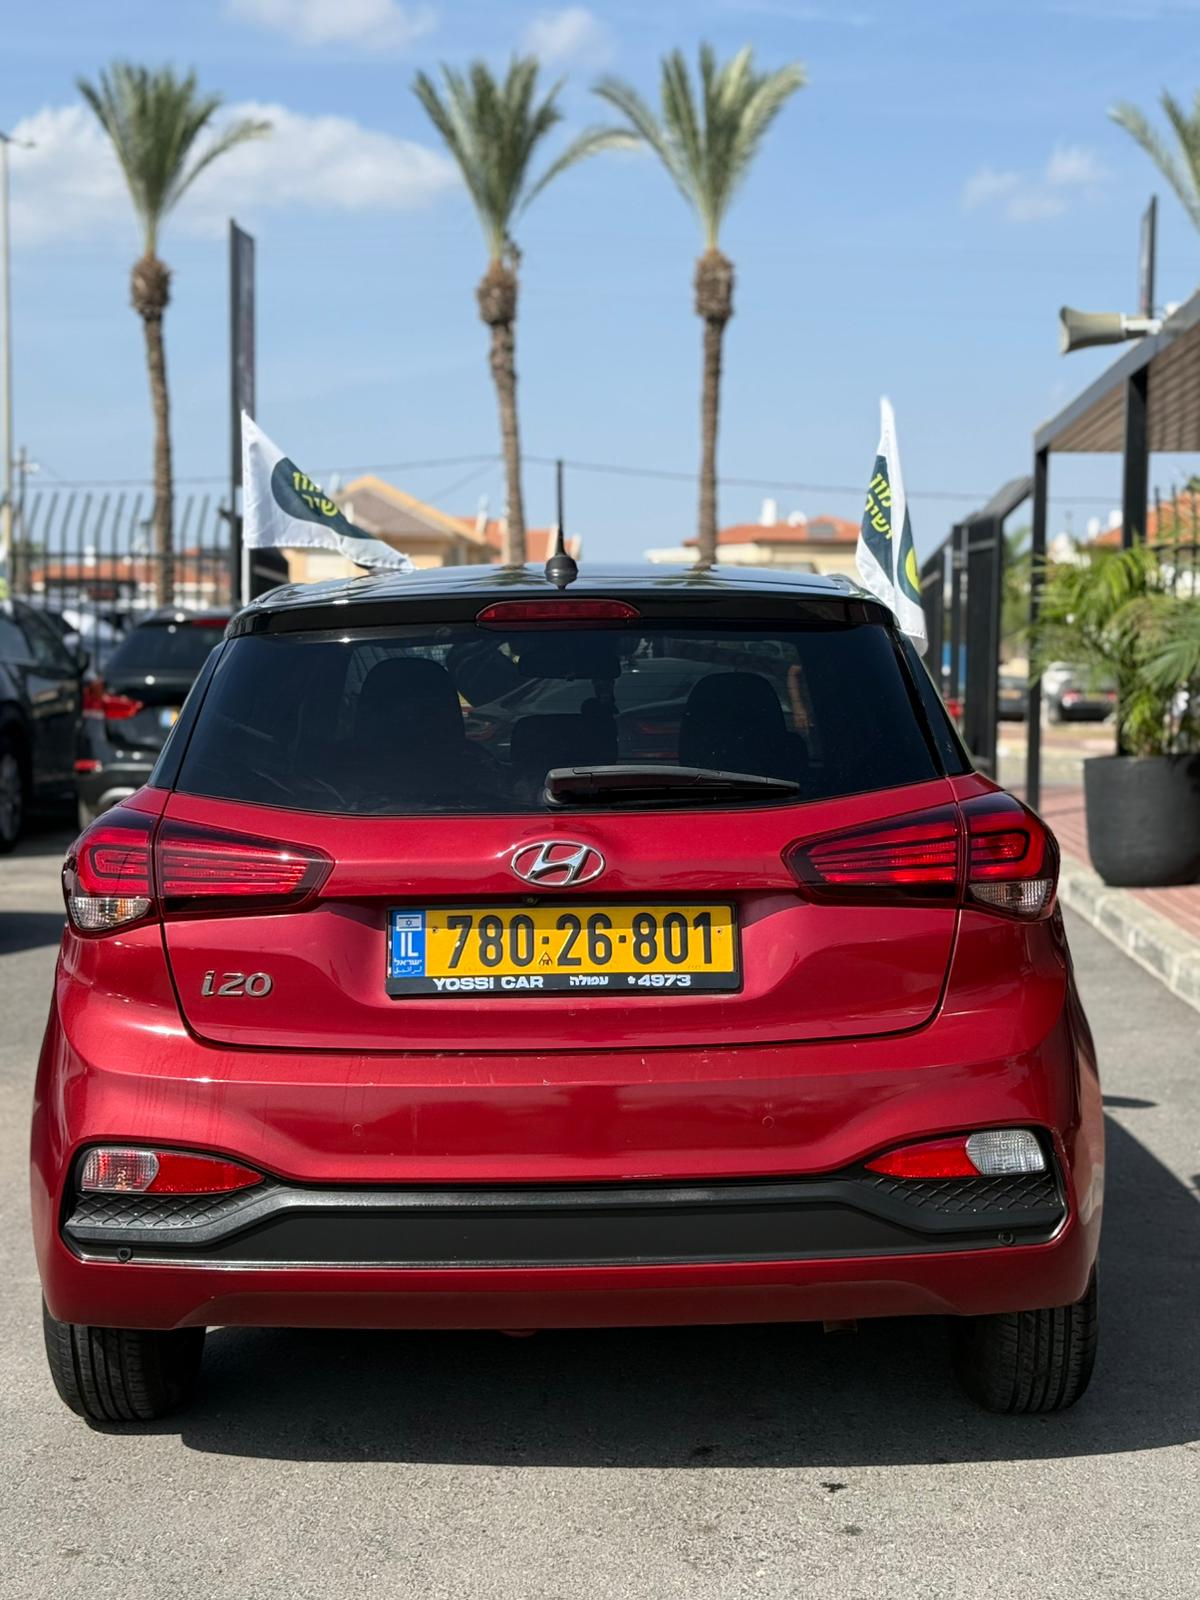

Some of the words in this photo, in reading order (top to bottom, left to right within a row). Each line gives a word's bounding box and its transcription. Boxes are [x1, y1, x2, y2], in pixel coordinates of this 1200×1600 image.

[301, 493, 337, 517] שיר
[400, 932, 419, 957] IL
[201, 970, 272, 997] i20
[433, 977, 495, 991] YOSSI
[500, 976, 544, 989] CAR
[569, 975, 609, 986] עפולה
